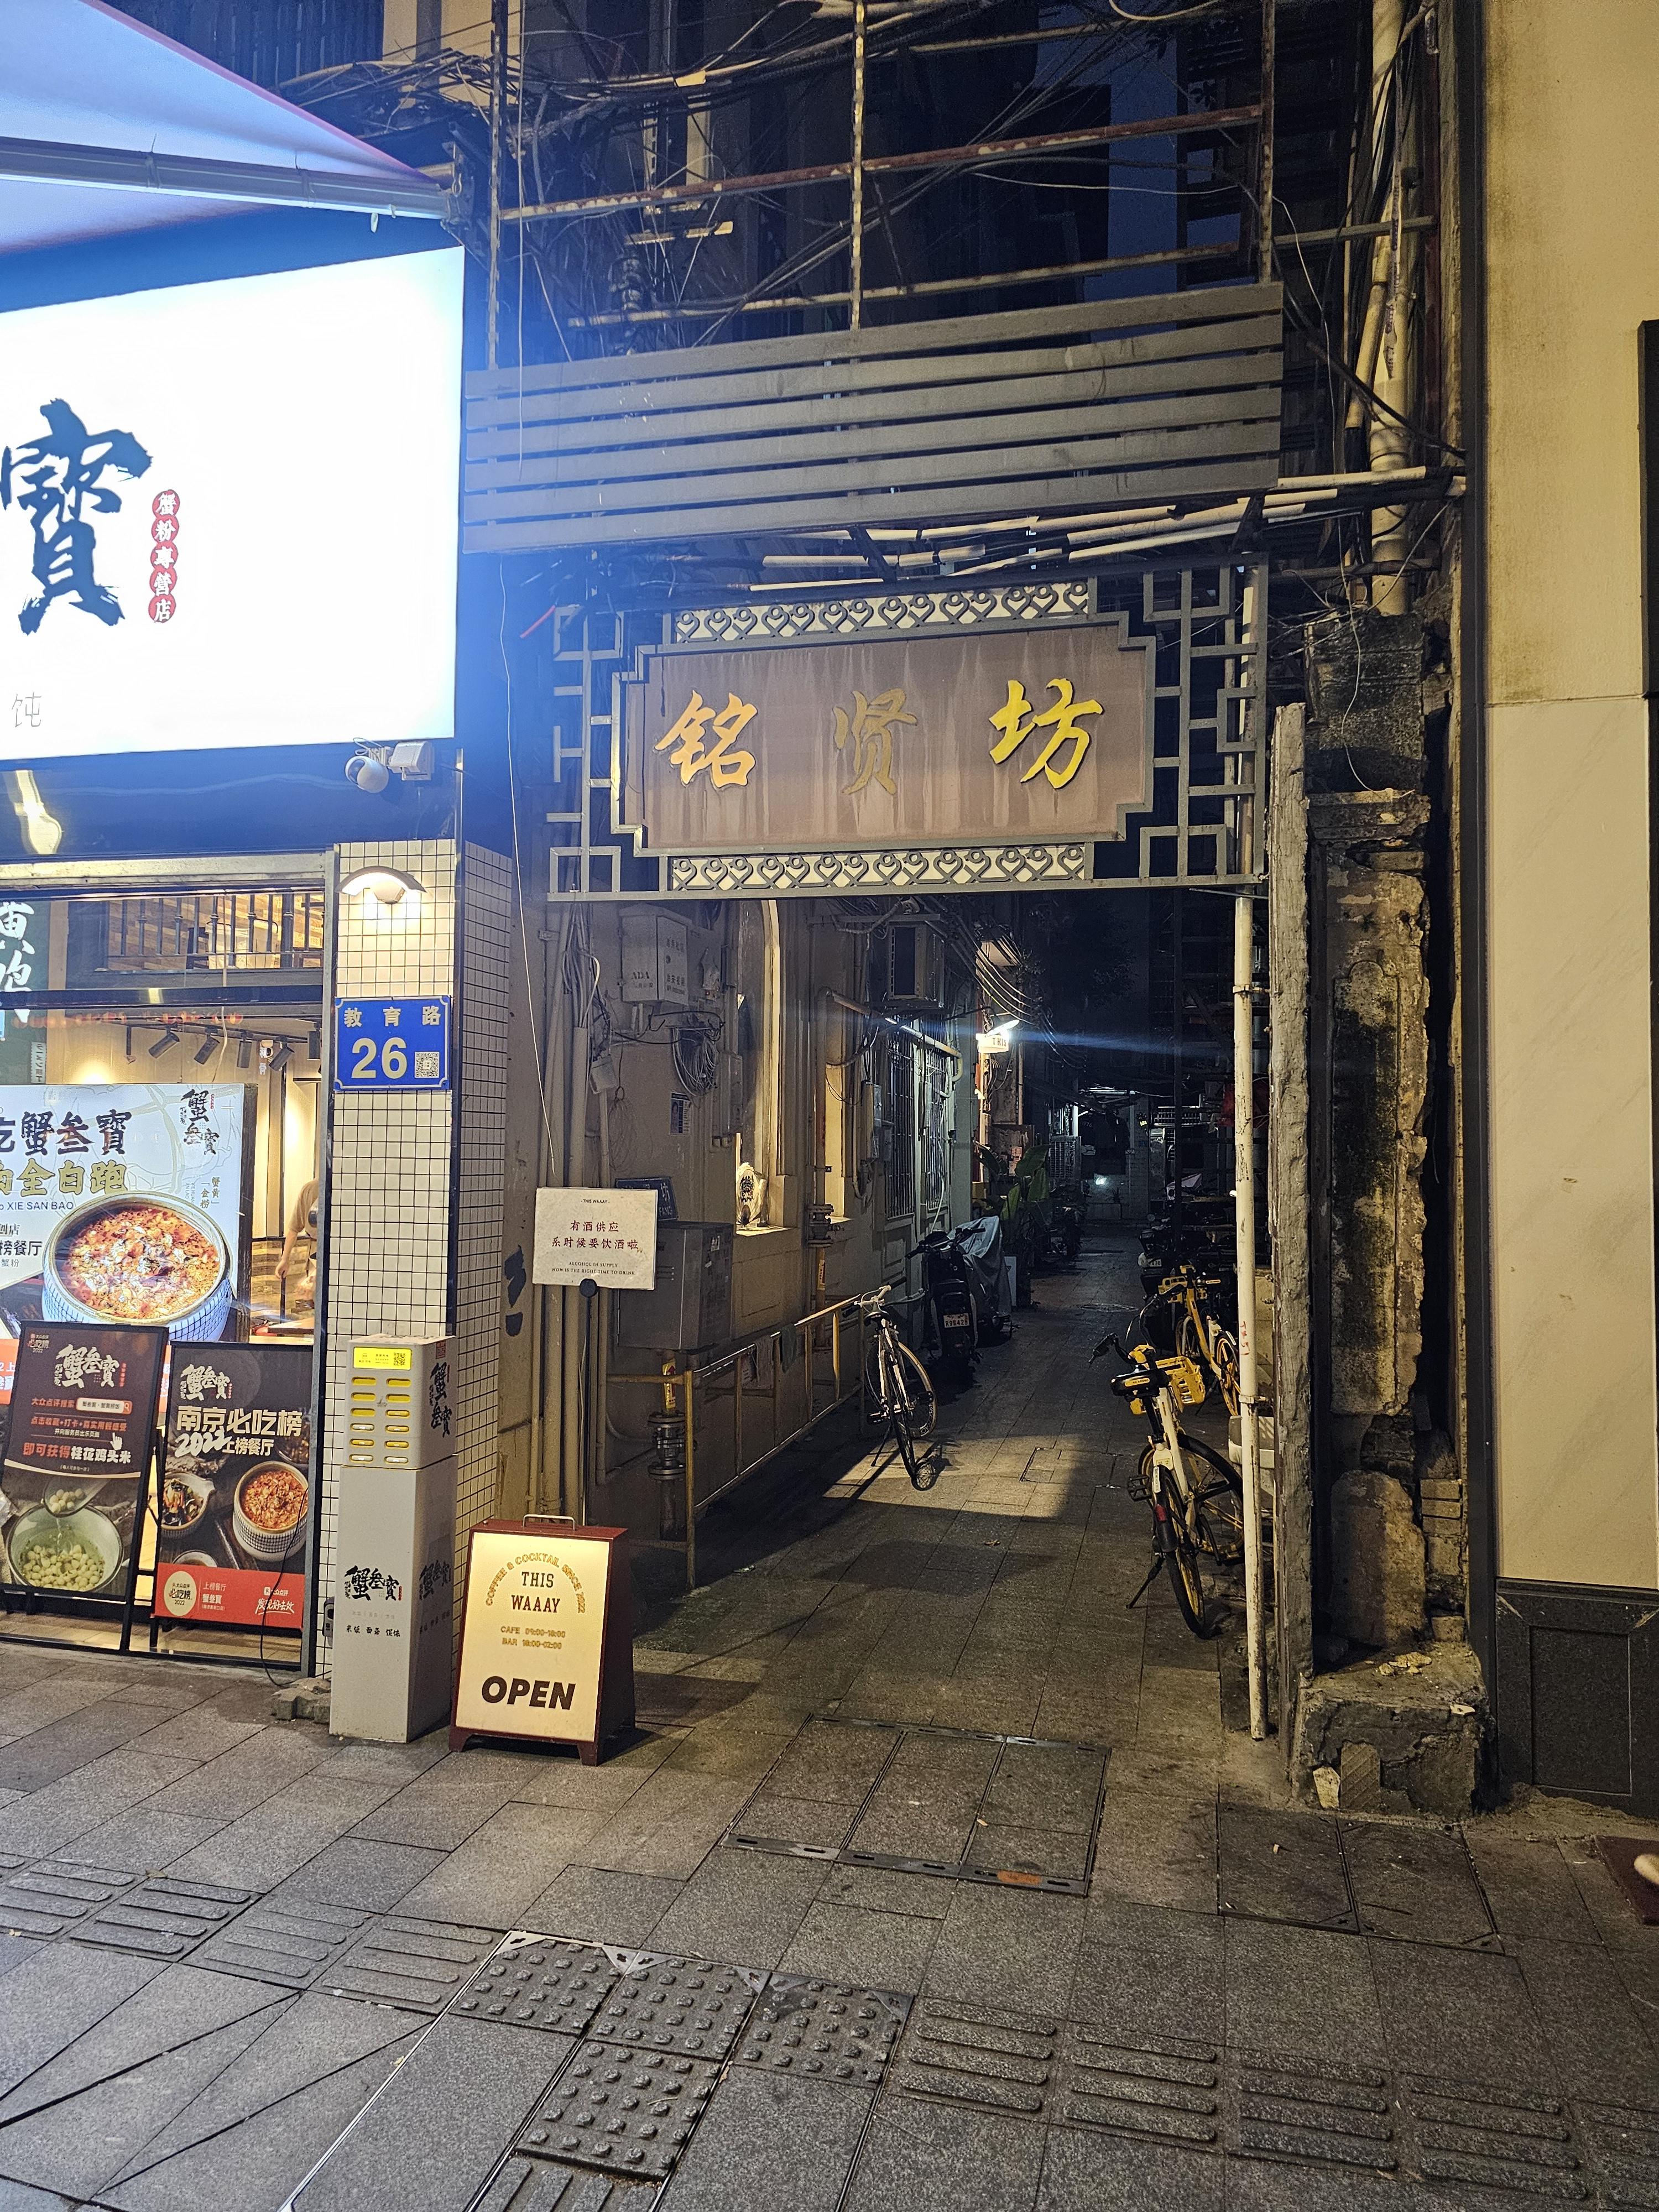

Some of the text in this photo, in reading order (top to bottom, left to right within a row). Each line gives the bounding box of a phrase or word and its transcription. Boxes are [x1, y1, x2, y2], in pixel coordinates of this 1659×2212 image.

[654, 678, 1104, 795] 铭贤坊
[344, 1005, 441, 1027] 教育路
[351, 1037, 407, 1079] 26
[7, 1202, 23, 1210] XIE
[27, 1202, 48, 1211] SAN
[51, 1202, 73, 1211] BAO
[570, 1220, 619, 1232] 有酒供应
[177, 1406, 302, 1437] 南京必吃榜
[174, 1430, 274, 1458] 2022 上榜餐厅
[486, 1568, 507, 1606] COFFEE
[507, 1562, 514, 1570] &
[515, 1552, 560, 1568] COCKTAIL
[522, 1572, 554, 1588] THIS
[511, 1594, 561, 1613] WAAAY
[482, 1676, 576, 1710] OPEN
